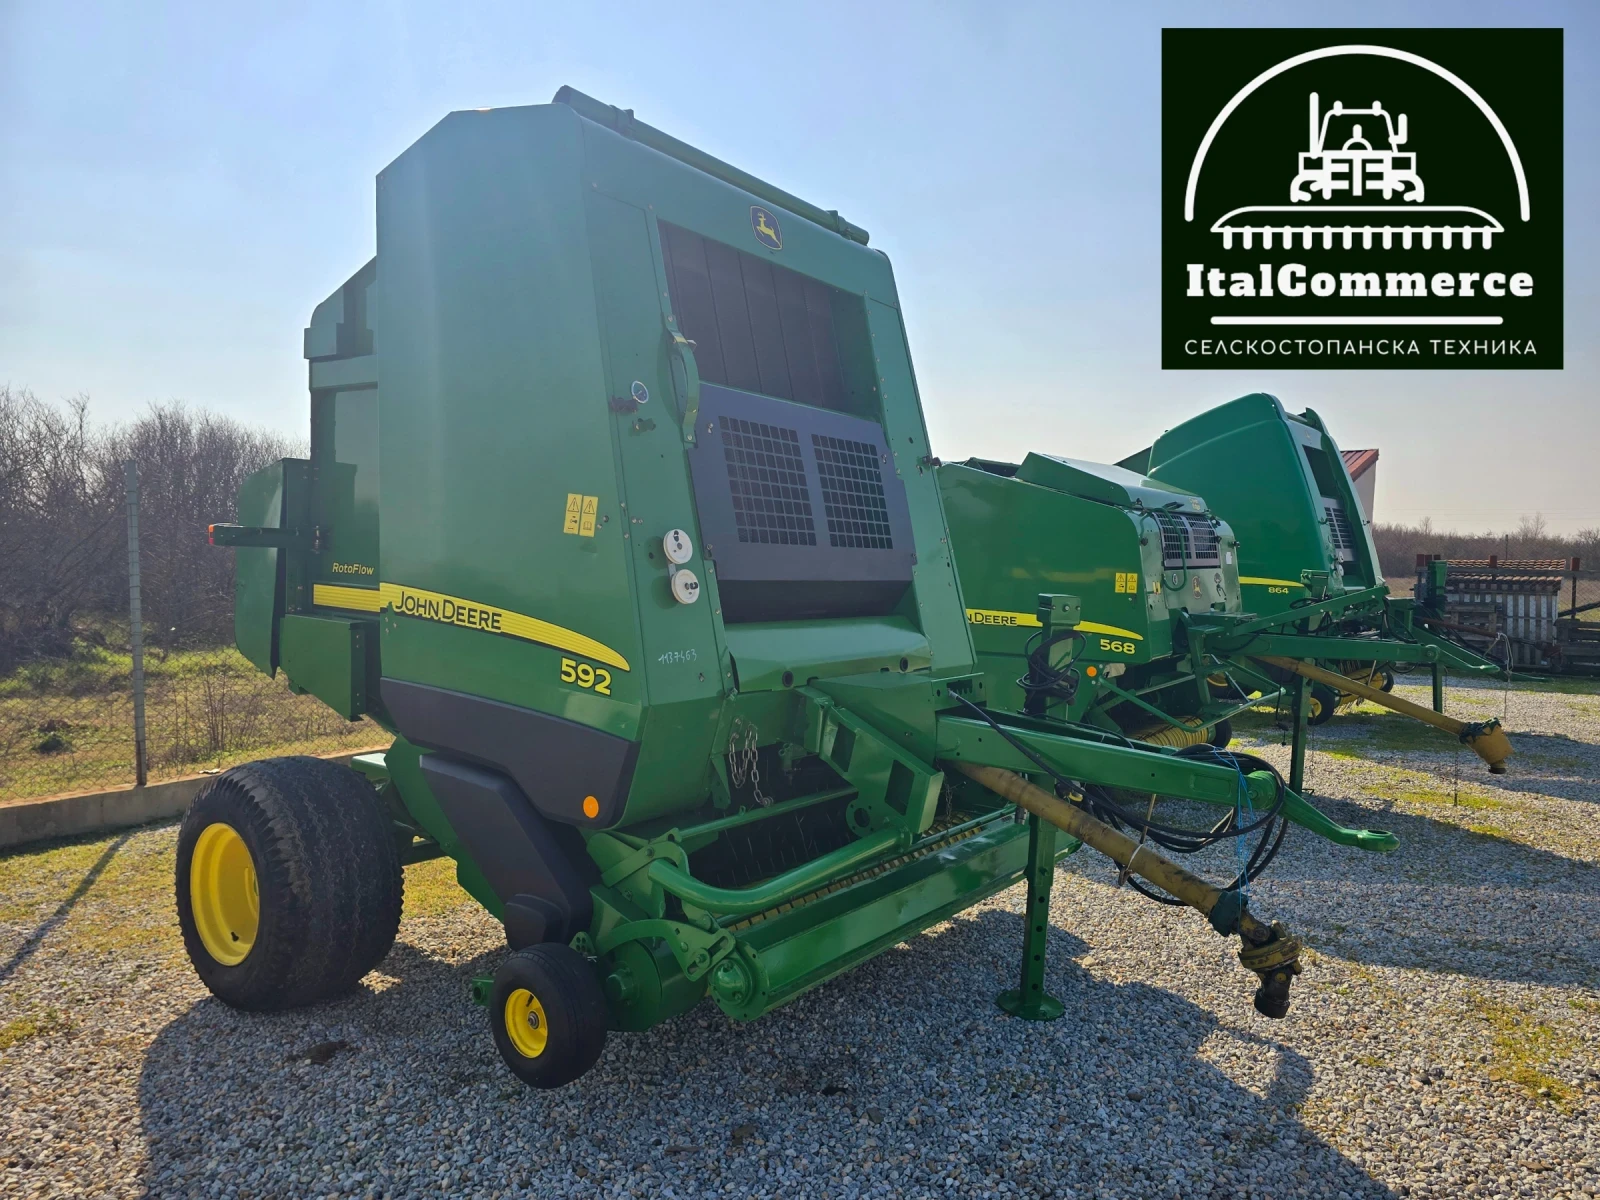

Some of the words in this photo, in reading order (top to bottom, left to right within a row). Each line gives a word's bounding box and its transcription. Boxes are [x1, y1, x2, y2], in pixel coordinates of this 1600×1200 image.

[332, 562, 375, 576] RotoFlow
[1268, 586, 1289, 595] 864
[395, 590, 440, 618] JOHN
[442, 599, 502, 631] DEERE
[974, 612, 1018, 625] DEERE
[1100, 638, 1136, 655] 568
[561, 657, 612, 696] 592
